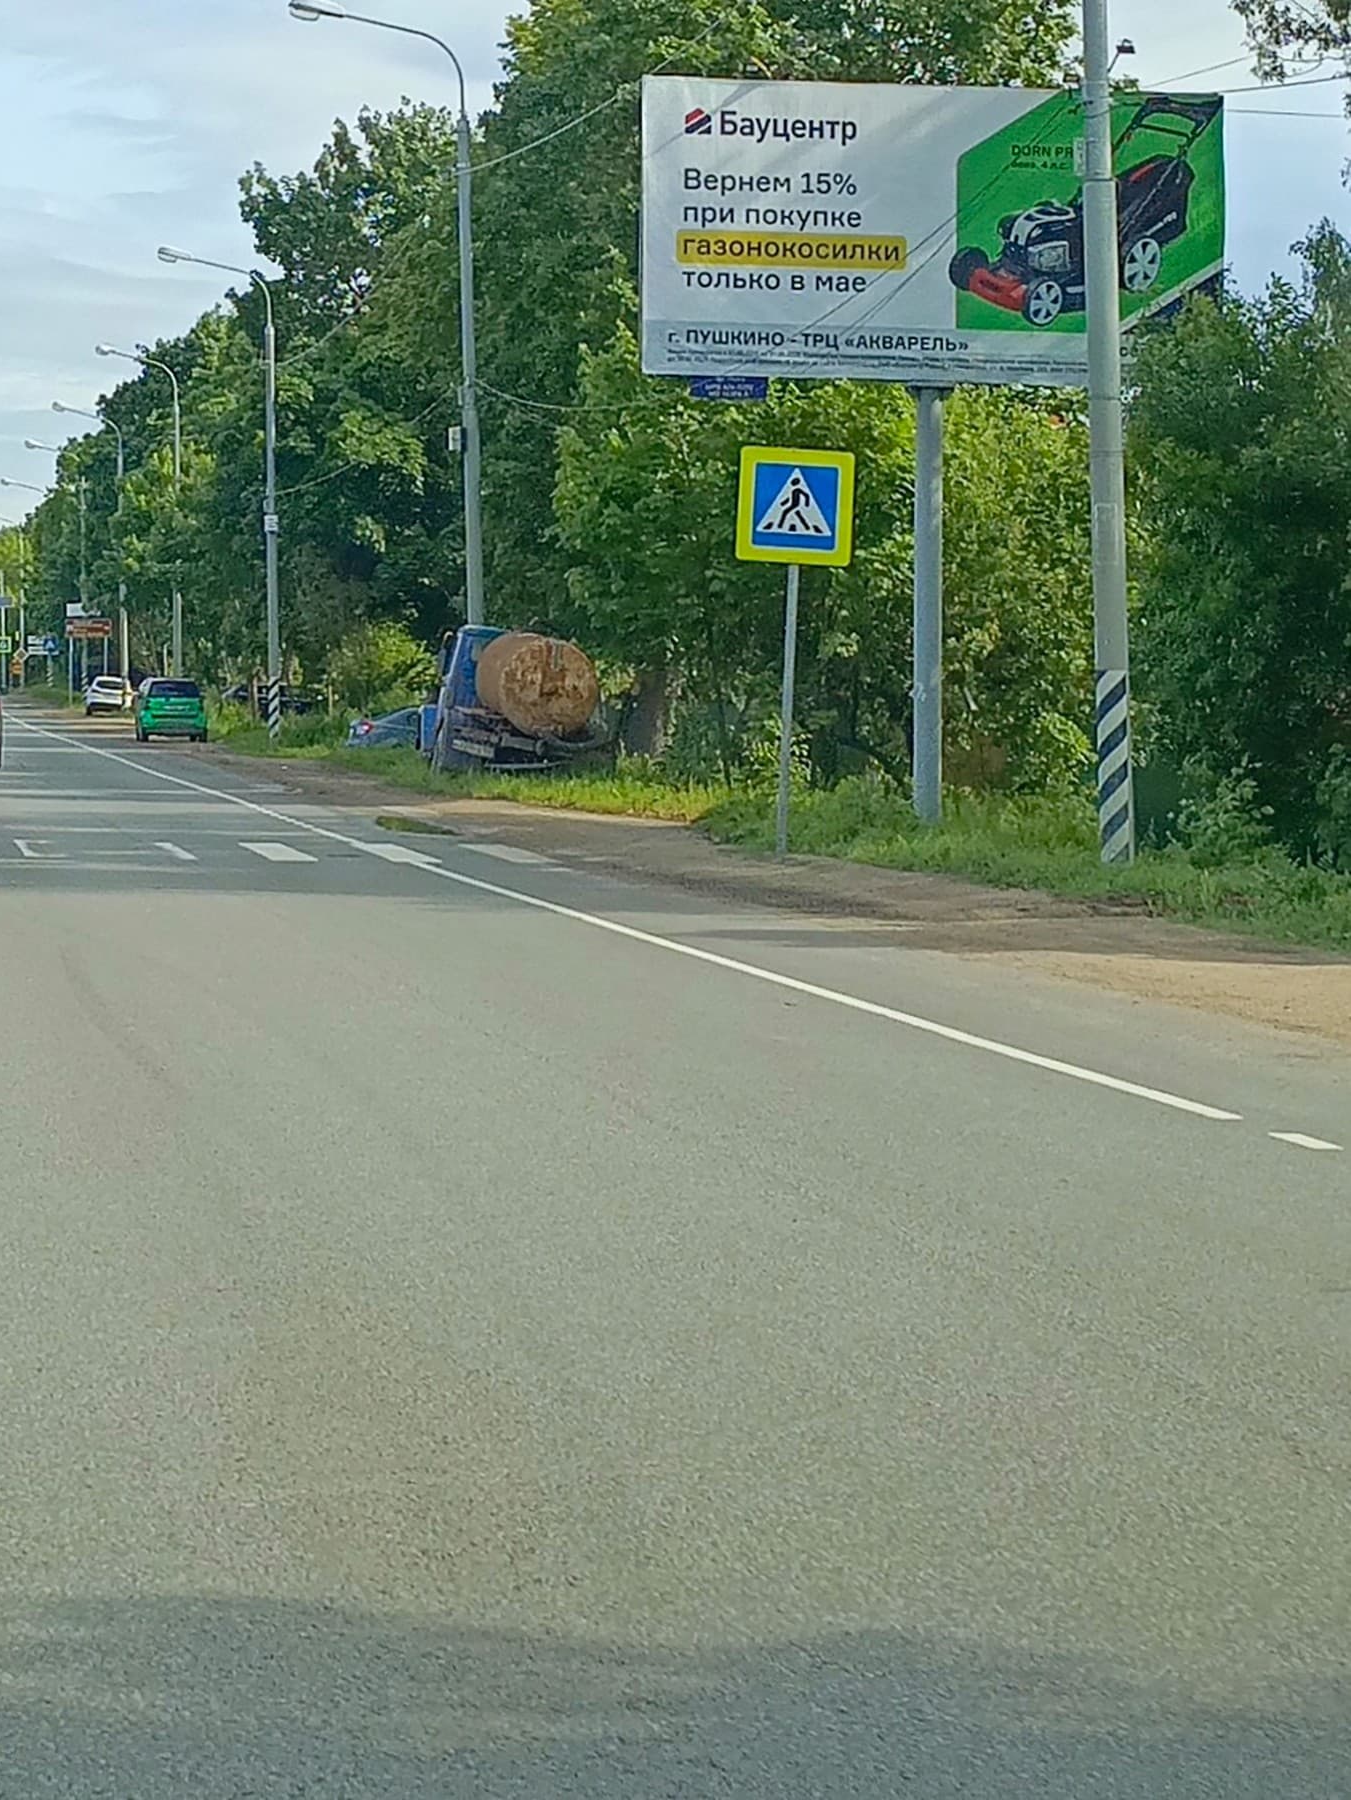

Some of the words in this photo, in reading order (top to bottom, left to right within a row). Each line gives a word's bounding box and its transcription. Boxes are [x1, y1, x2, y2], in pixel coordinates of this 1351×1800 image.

[720, 111, 857, 146] Бауцентр
[1011, 144, 1051, 157] DORN
[684, 168, 791, 196] Вернем
[801, 172, 857, 196] 15%
[683, 206, 734, 228] при
[746, 208, 862, 231] покупке
[683, 238, 899, 261] газонокосилки
[682, 271, 780, 290] только
[791, 274, 805, 290] в
[816, 276, 867, 293] мае
[668, 332, 681, 344] г.
[686, 330, 784, 346] ПУШКИНО
[802, 333, 839, 350] ТРЦ
[845, 335, 969, 351] «АКВАРЕЛЬ»
